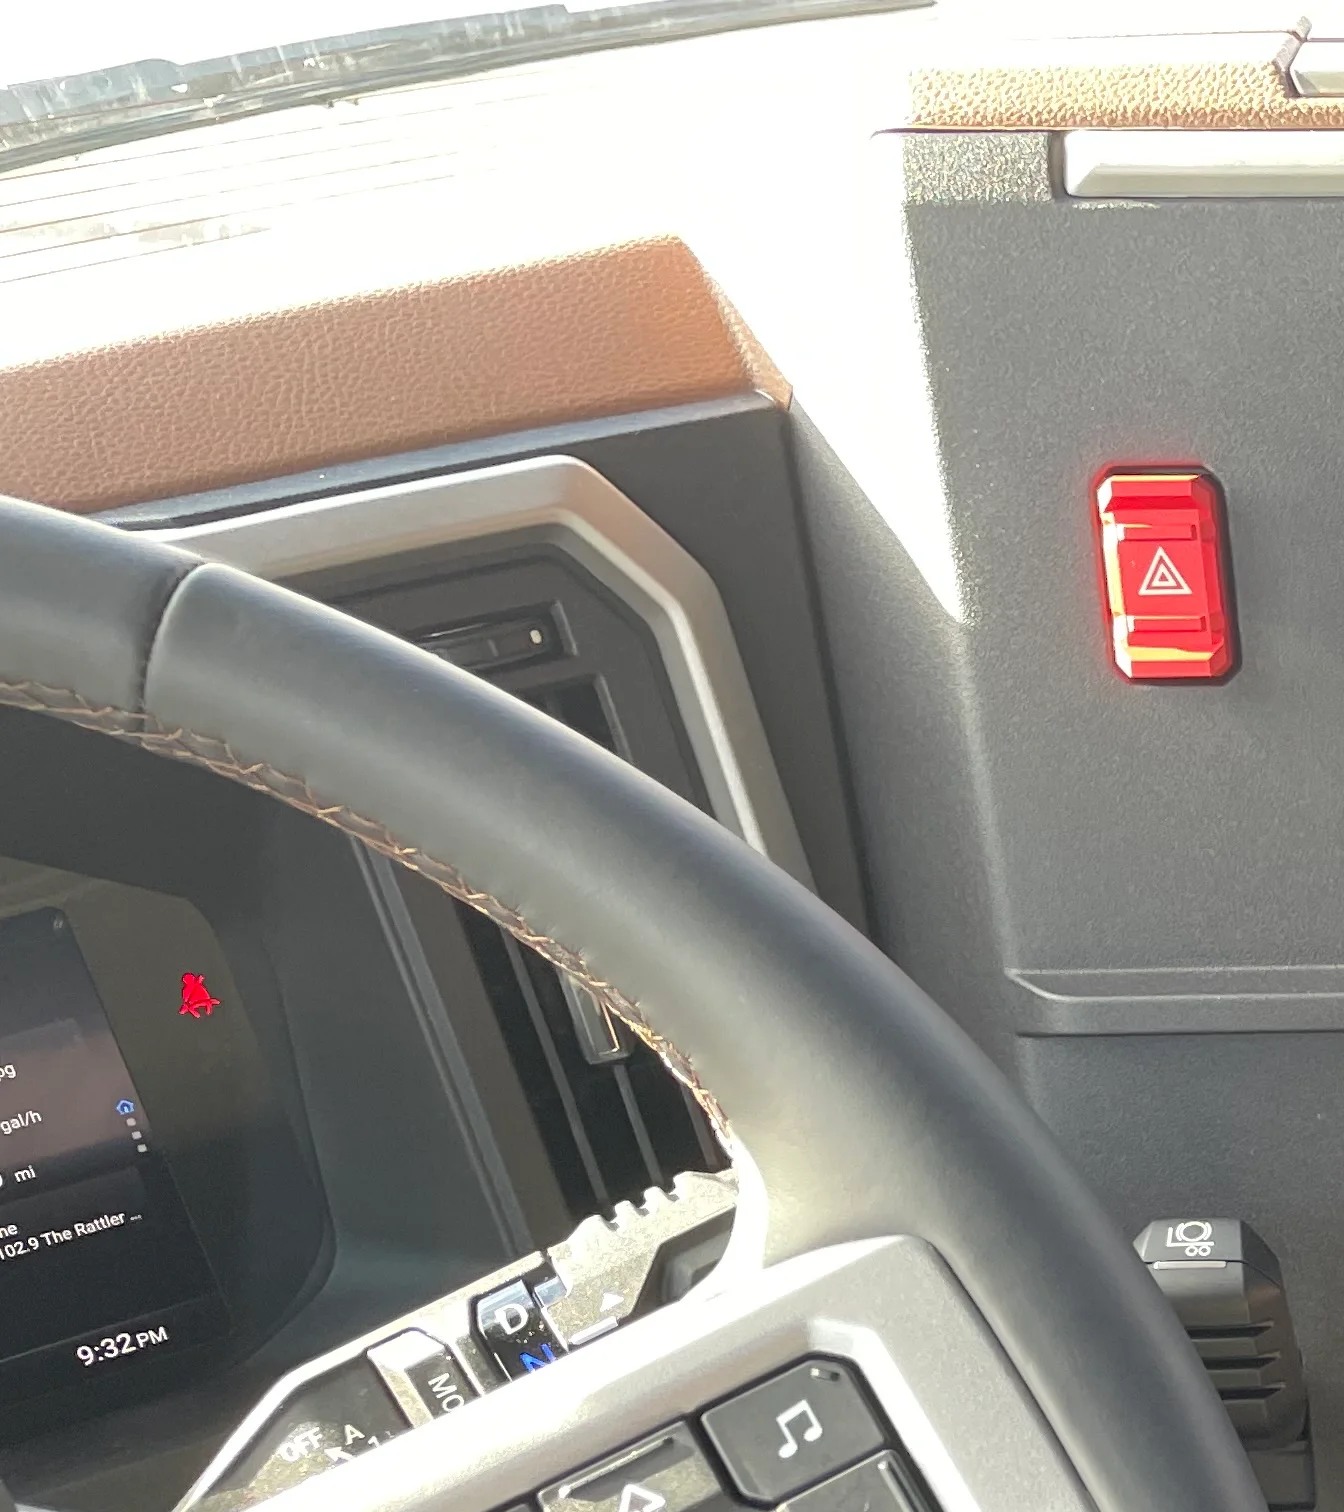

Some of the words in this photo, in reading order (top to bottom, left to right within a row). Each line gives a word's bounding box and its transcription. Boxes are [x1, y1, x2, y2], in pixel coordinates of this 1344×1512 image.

[0, 1110, 42, 1135] gal/h
[14, 1165, 36, 1183] mi
[40, 1230, 73, 1246] The
[74, 1213, 125, 1237] Rattler
[494, 1303, 529, 1335] D
[77, 1333, 136, 1366] 9:32
[135, 1326, 169, 1348] PM
[428, 1372, 465, 1413] MO
